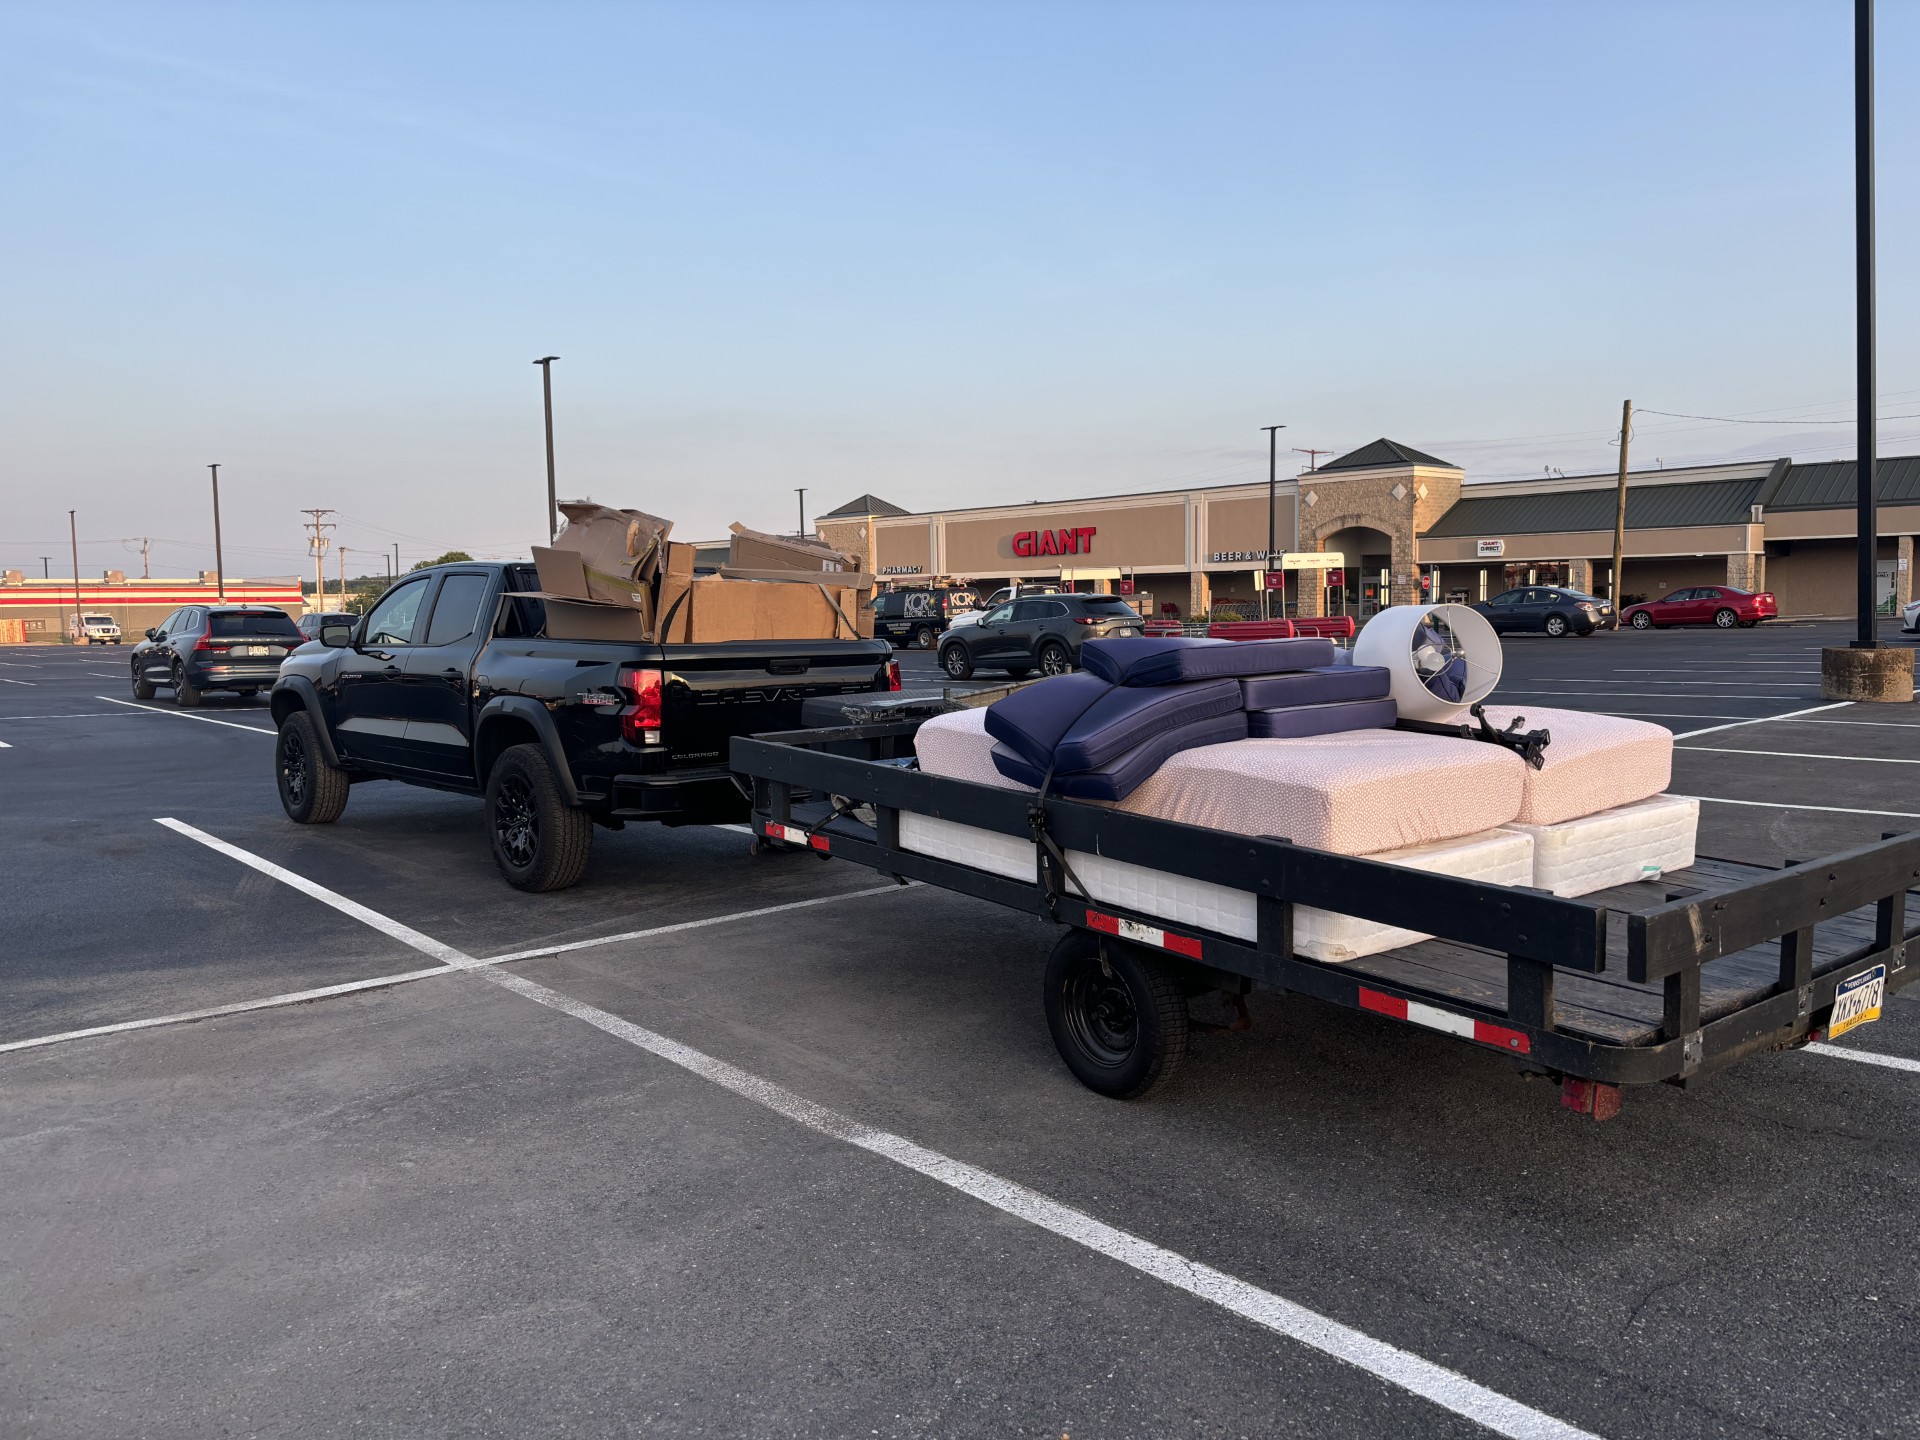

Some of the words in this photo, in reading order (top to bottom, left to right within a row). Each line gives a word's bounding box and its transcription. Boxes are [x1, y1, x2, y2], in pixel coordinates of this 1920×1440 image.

[1012, 527, 1097, 557] GIANT
[1213, 551, 1242, 561] BEER
[1245, 551, 1252, 560] &
[882, 565, 923, 575] PHARMACY
[904, 592, 930, 611] KCR
[949, 592, 974, 606] KCR
[1847, 973, 1872, 989] PENNSYLVANIA
[1843, 1013, 1864, 1029] TRAILER
